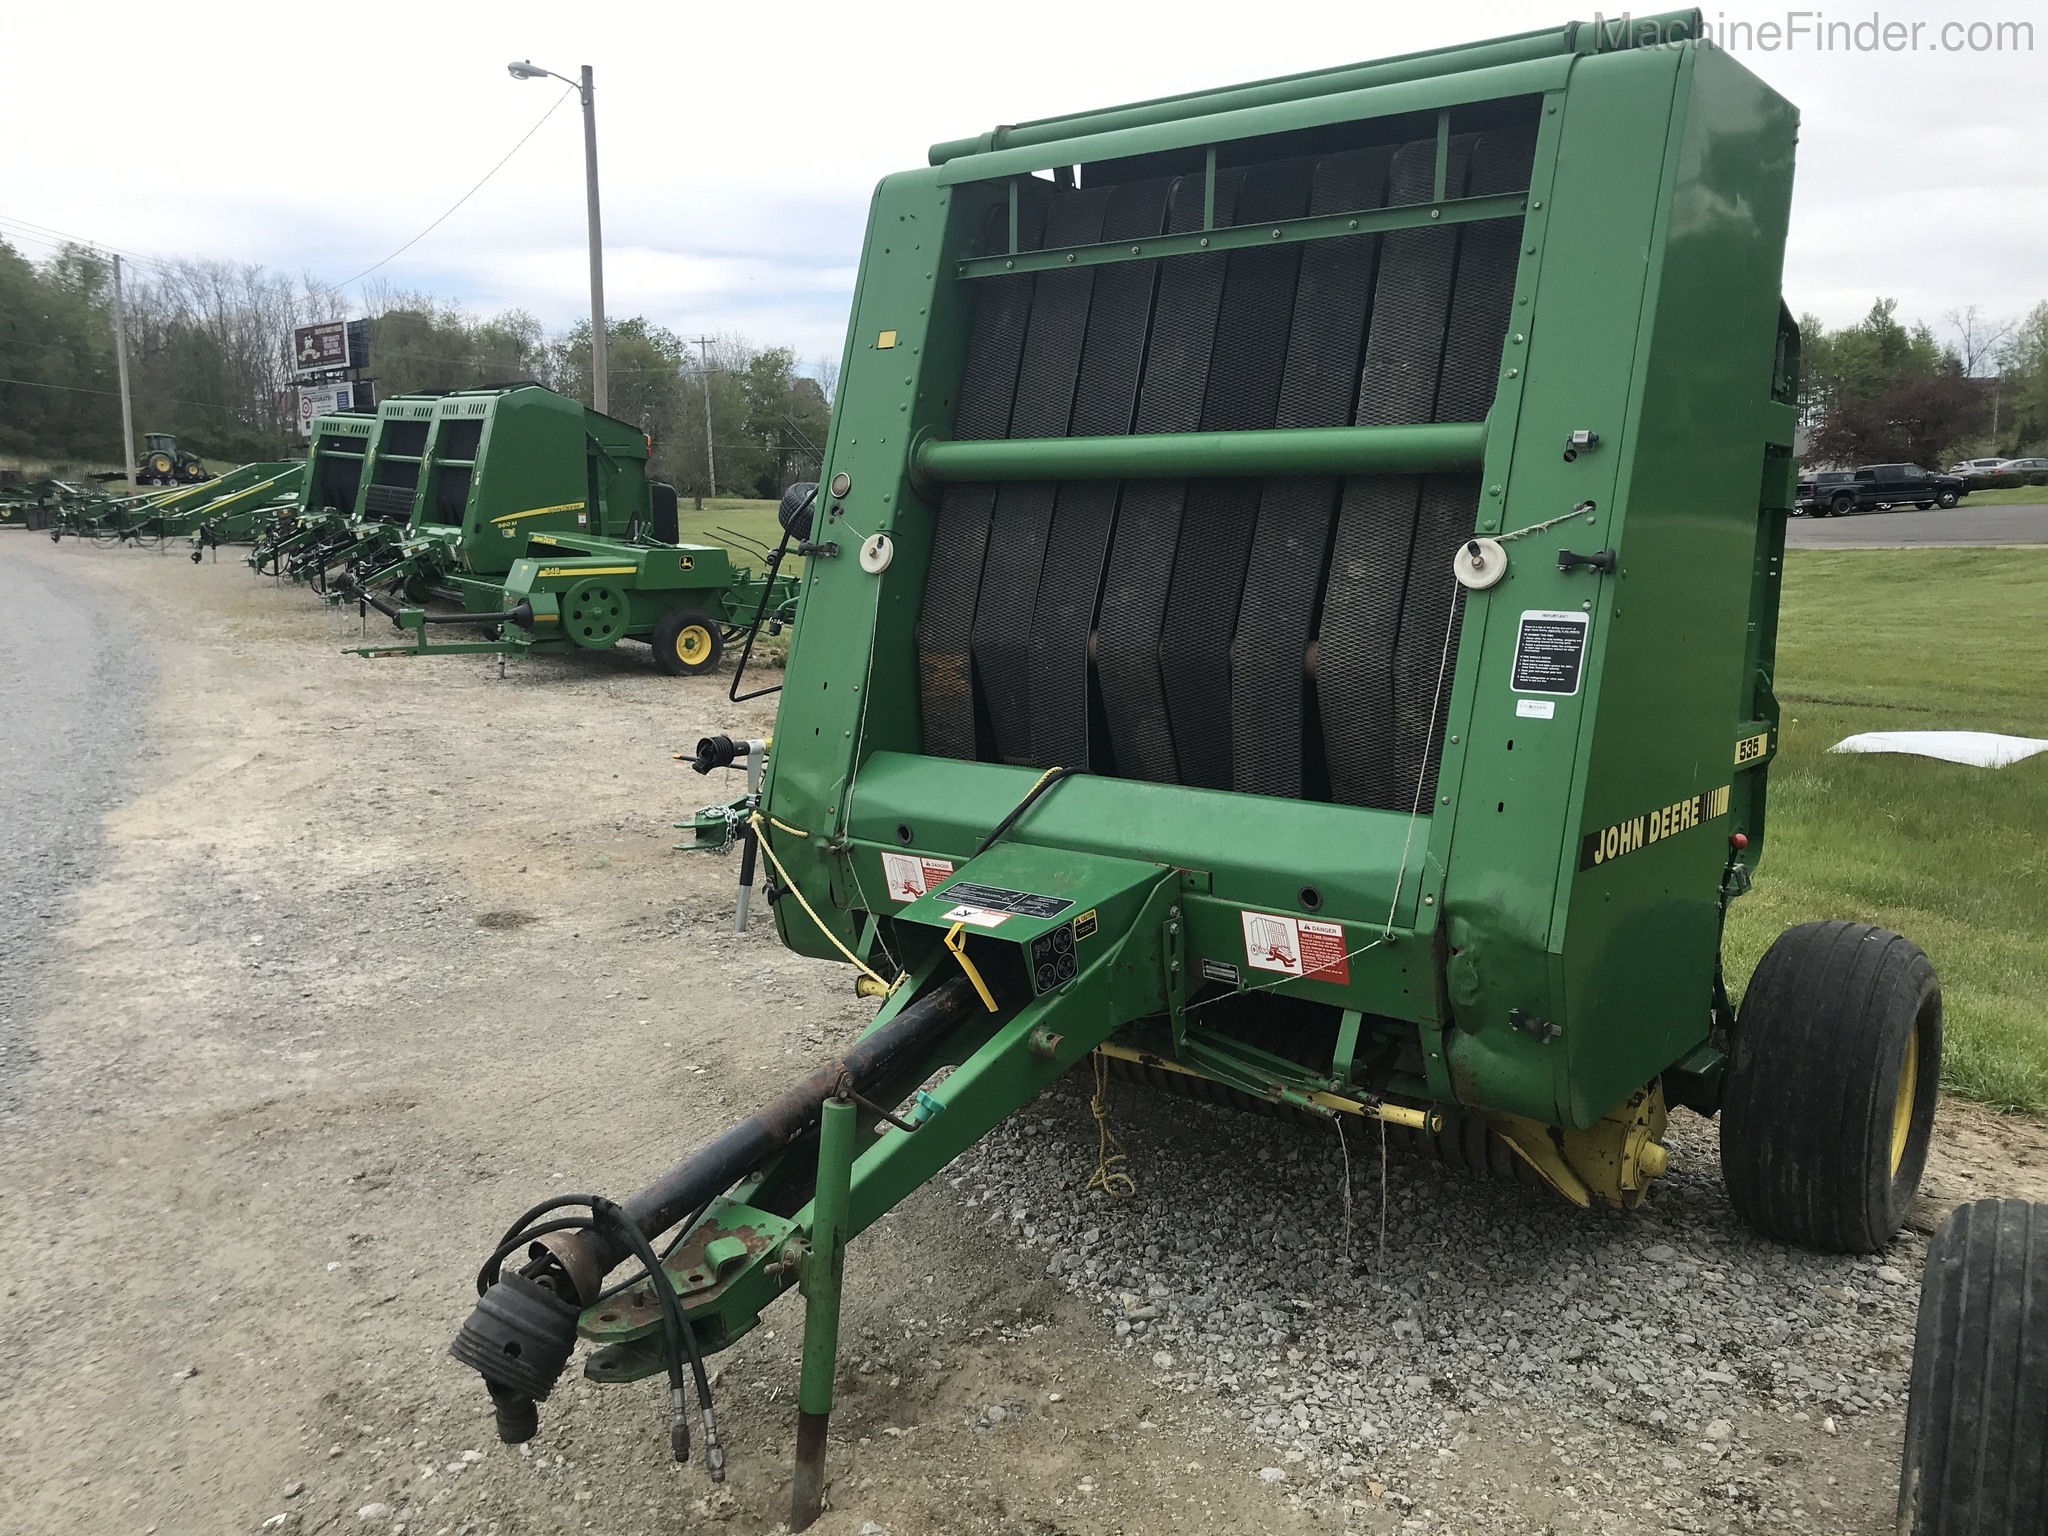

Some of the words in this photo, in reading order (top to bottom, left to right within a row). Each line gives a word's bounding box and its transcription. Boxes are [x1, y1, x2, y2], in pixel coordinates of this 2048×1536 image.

[532, 535, 545, 543] JOHN
[544, 537, 557, 545] DEERE
[545, 567, 561, 575] 348
[1739, 737, 1759, 761] 535
[1594, 815, 1645, 865] JOHN
[1649, 795, 1700, 844] DEERE
[1312, 925, 1337, 934] DANGER
